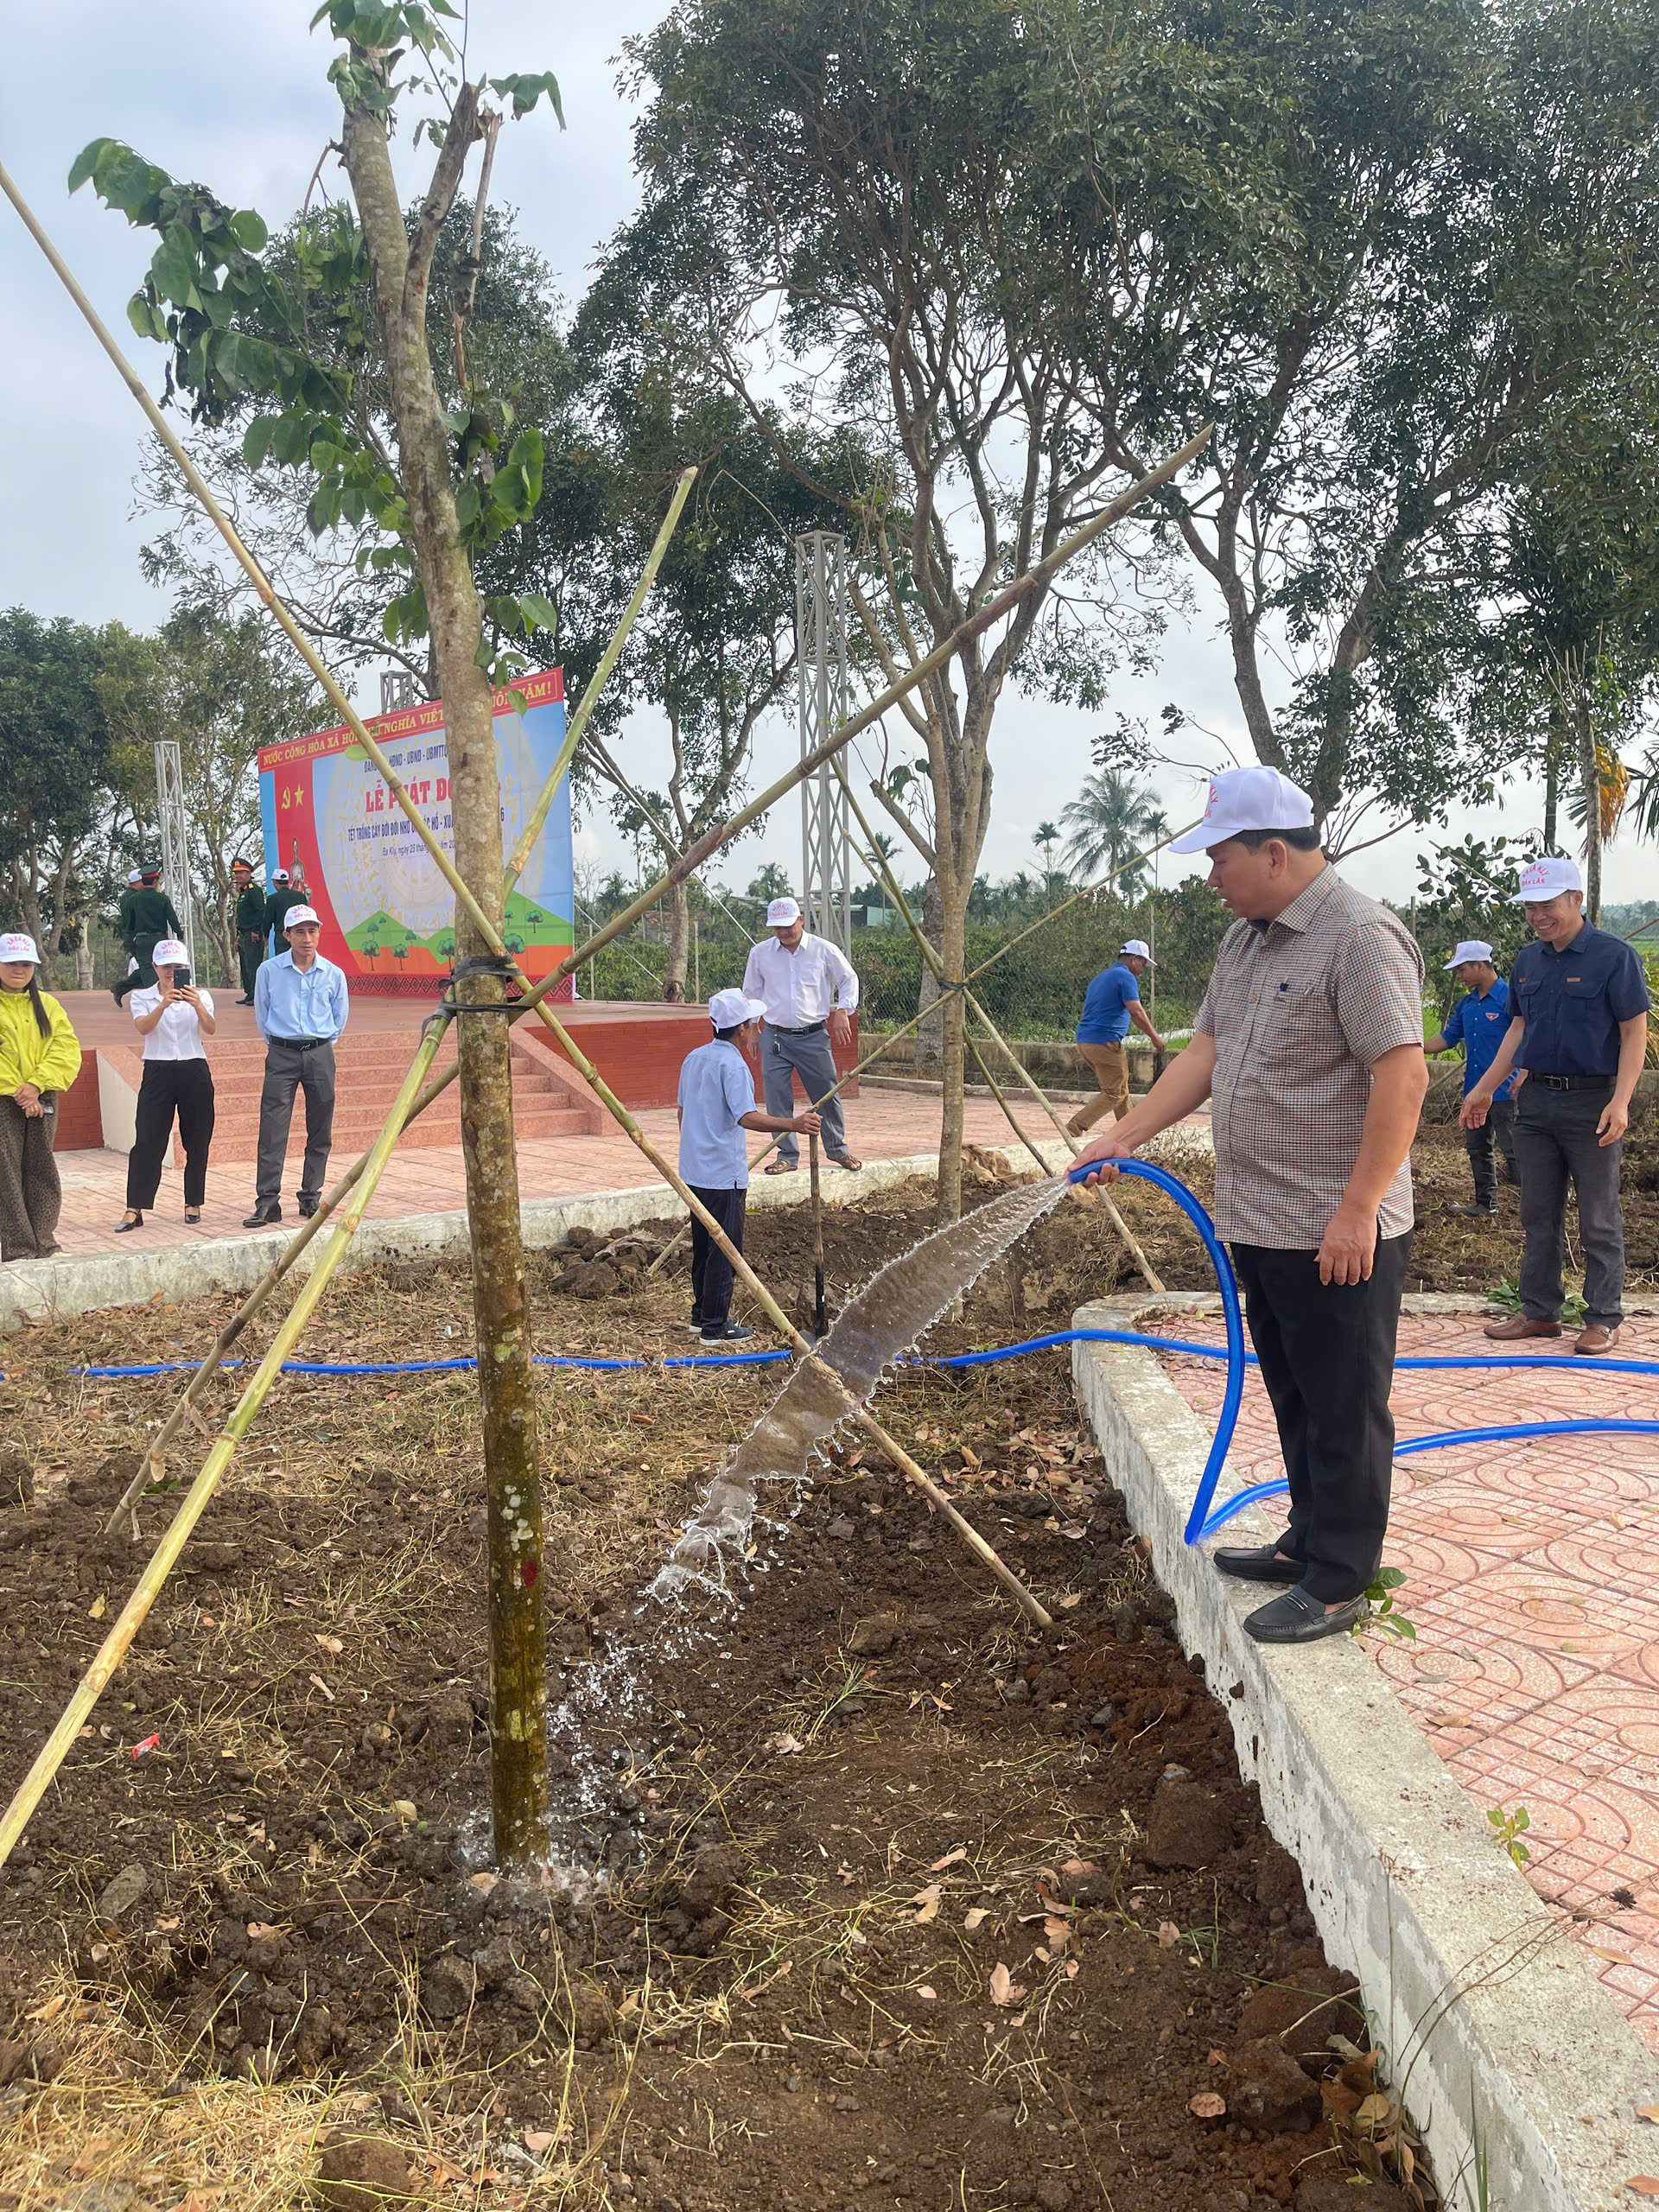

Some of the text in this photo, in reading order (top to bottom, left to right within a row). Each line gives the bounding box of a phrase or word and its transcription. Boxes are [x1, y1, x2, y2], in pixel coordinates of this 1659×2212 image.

[284, 745, 306, 761] CỘNG
[308, 738, 326, 753] HÒA
[419, 708, 444, 726] VIỆT
[365, 779, 384, 813] LỄ
